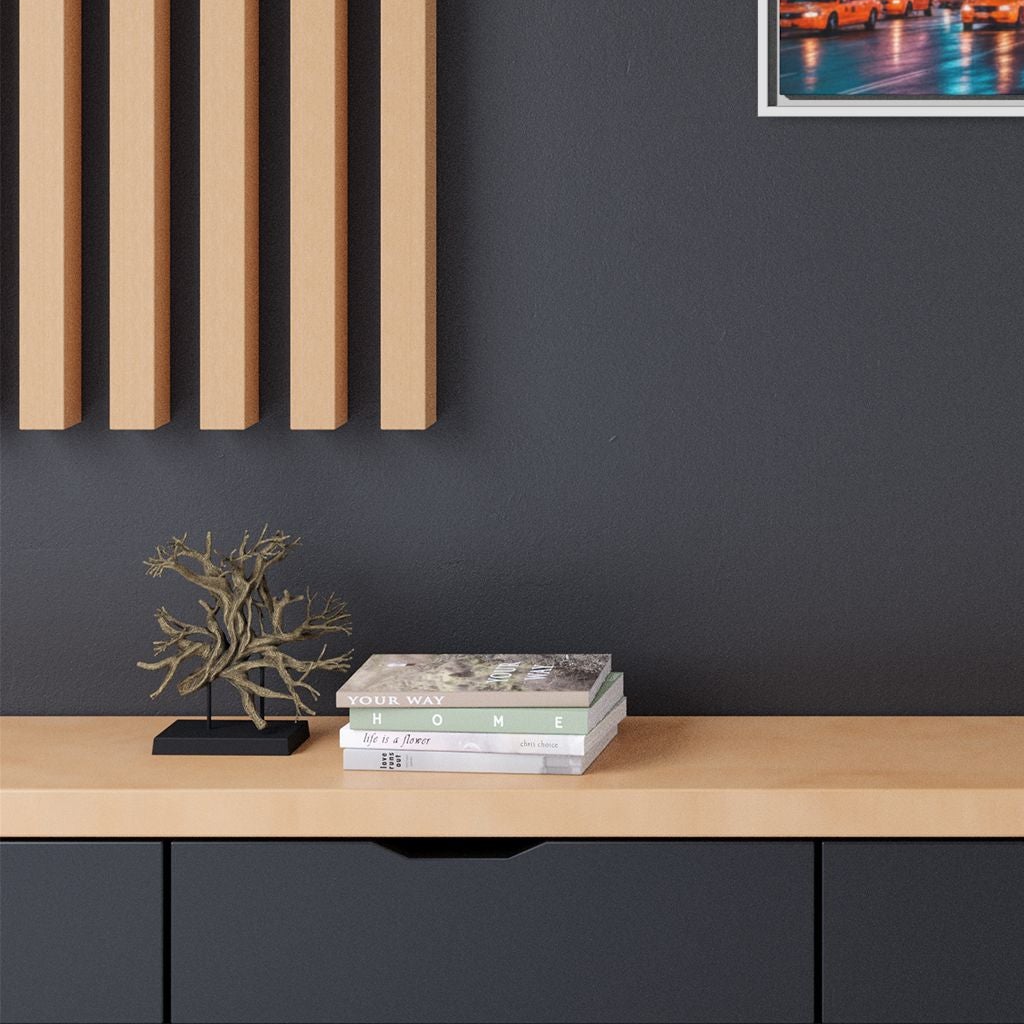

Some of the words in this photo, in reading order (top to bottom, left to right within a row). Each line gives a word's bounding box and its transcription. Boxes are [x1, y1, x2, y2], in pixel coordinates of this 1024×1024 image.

[486, 661, 521, 684] YOUR
[523, 664, 555, 681] WAY
[348, 695, 399, 705] YOUR
[406, 695, 446, 705] WAY
[372, 712, 563, 729] HOME
[362, 732, 379, 747] life
[381, 735, 390, 744] is
[400, 734, 431, 748] flower
[519, 739, 536, 748] chris
[380, 752, 388, 769] love
